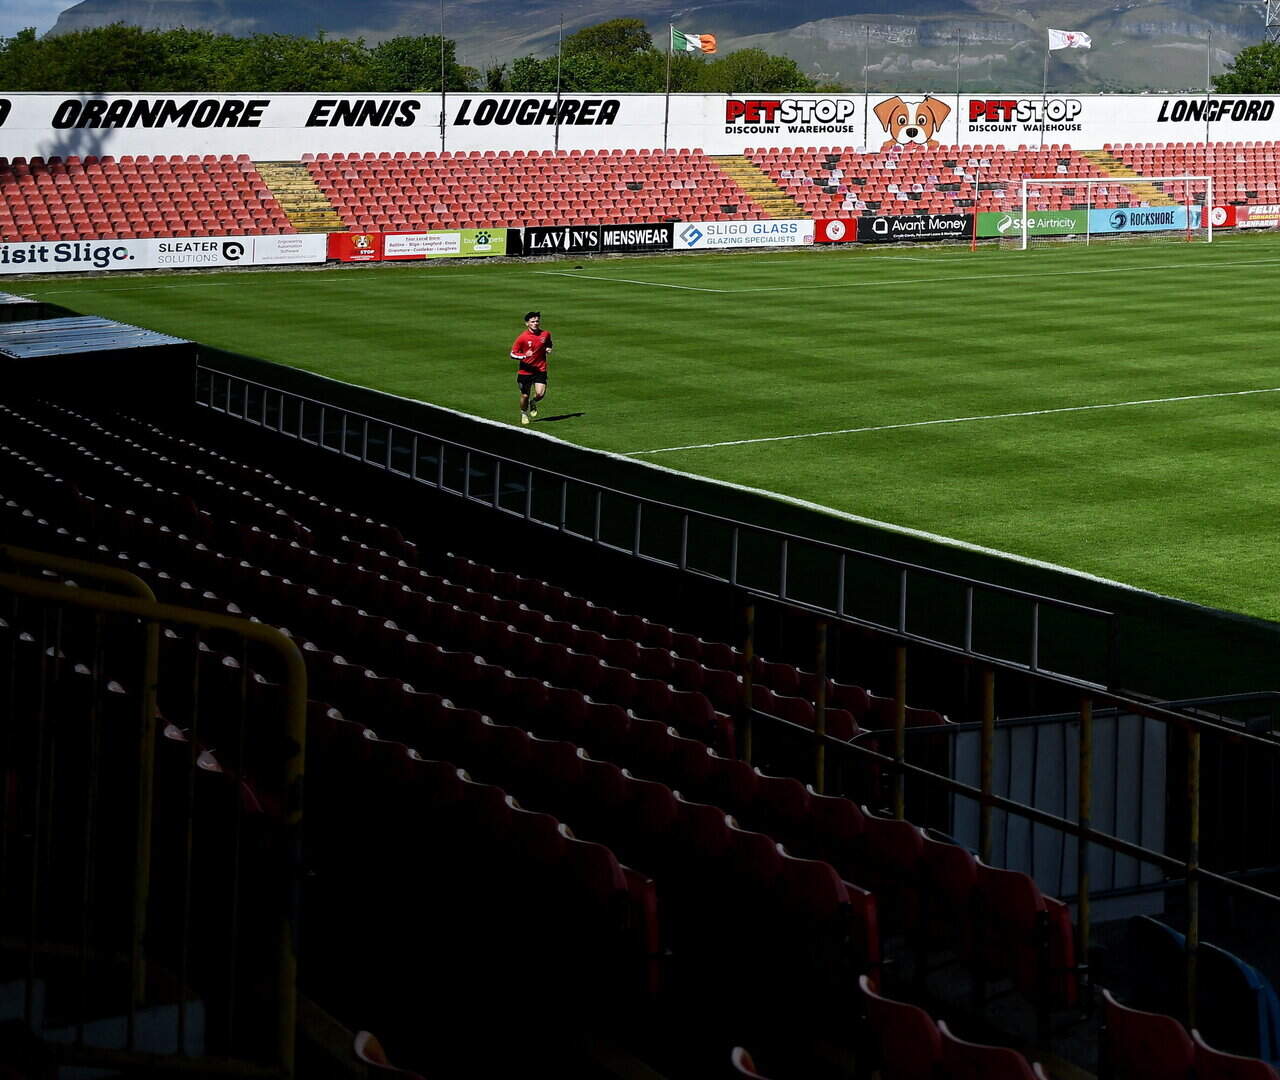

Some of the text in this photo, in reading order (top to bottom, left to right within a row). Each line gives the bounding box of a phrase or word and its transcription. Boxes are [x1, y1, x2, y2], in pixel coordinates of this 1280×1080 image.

[51, 98, 621, 129] ORANMORE ENNIS LOUGHREA
[1157, 99, 1276, 123] LONGFORD
[725, 123, 854, 135] DISCOUNT WAREHOUSE
[968, 123, 1082, 132] DISCOUNT WAREHOUSE
[1248, 204, 1280, 214] FELIX
[1036, 218, 1076, 230] Airtricity
[1130, 210, 1175, 226] ROCKSHORE
[706, 223, 798, 235] SLIGO GLASS
[891, 218, 967, 232] Avant Money
[603, 228, 669, 246] MENSWEAR
[706, 234, 796, 245] GLAZING SPECIALISTS
[158, 241, 218, 253] SLEATER
[0, 245, 49, 264] isit
[158, 253, 218, 264] SOLUTIONS
